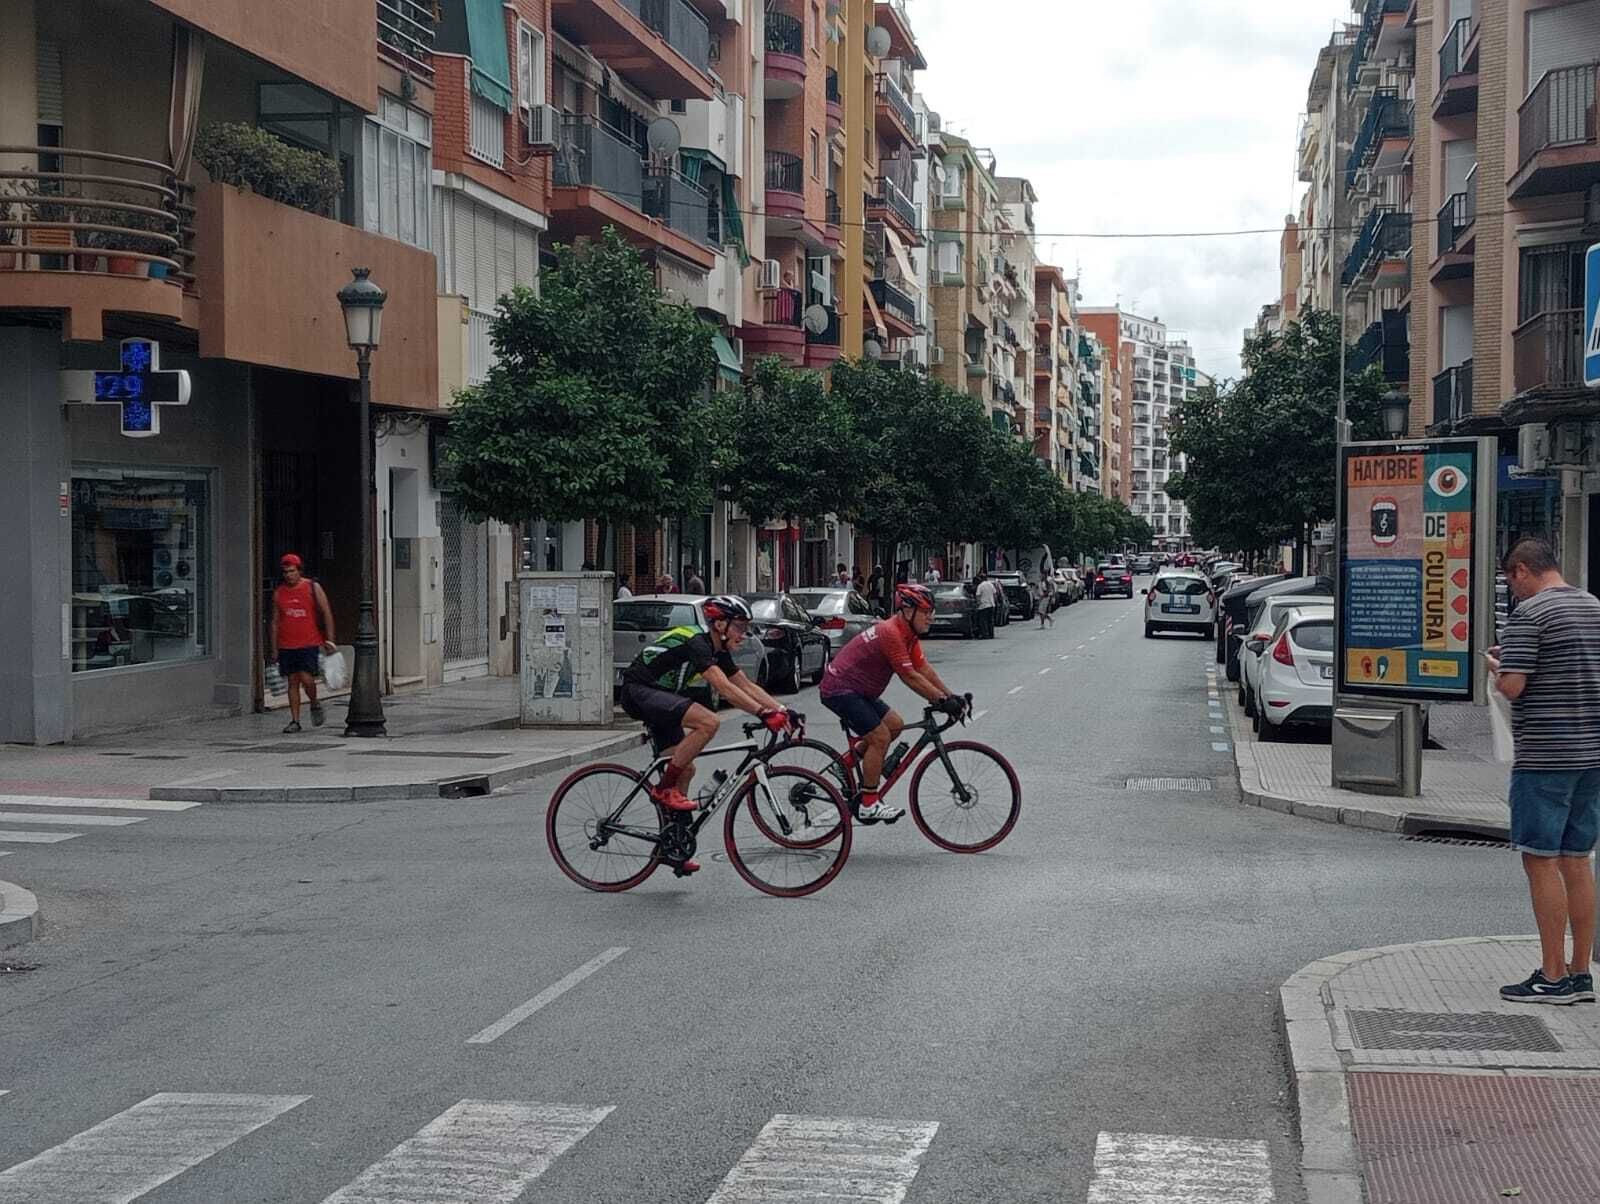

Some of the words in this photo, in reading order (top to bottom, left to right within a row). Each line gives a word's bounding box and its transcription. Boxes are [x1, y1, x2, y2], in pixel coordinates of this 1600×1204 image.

[1353, 457, 1417, 481] HAMBRE
[1425, 515, 1446, 537] DE
[1425, 551, 1445, 640] CULTURA
